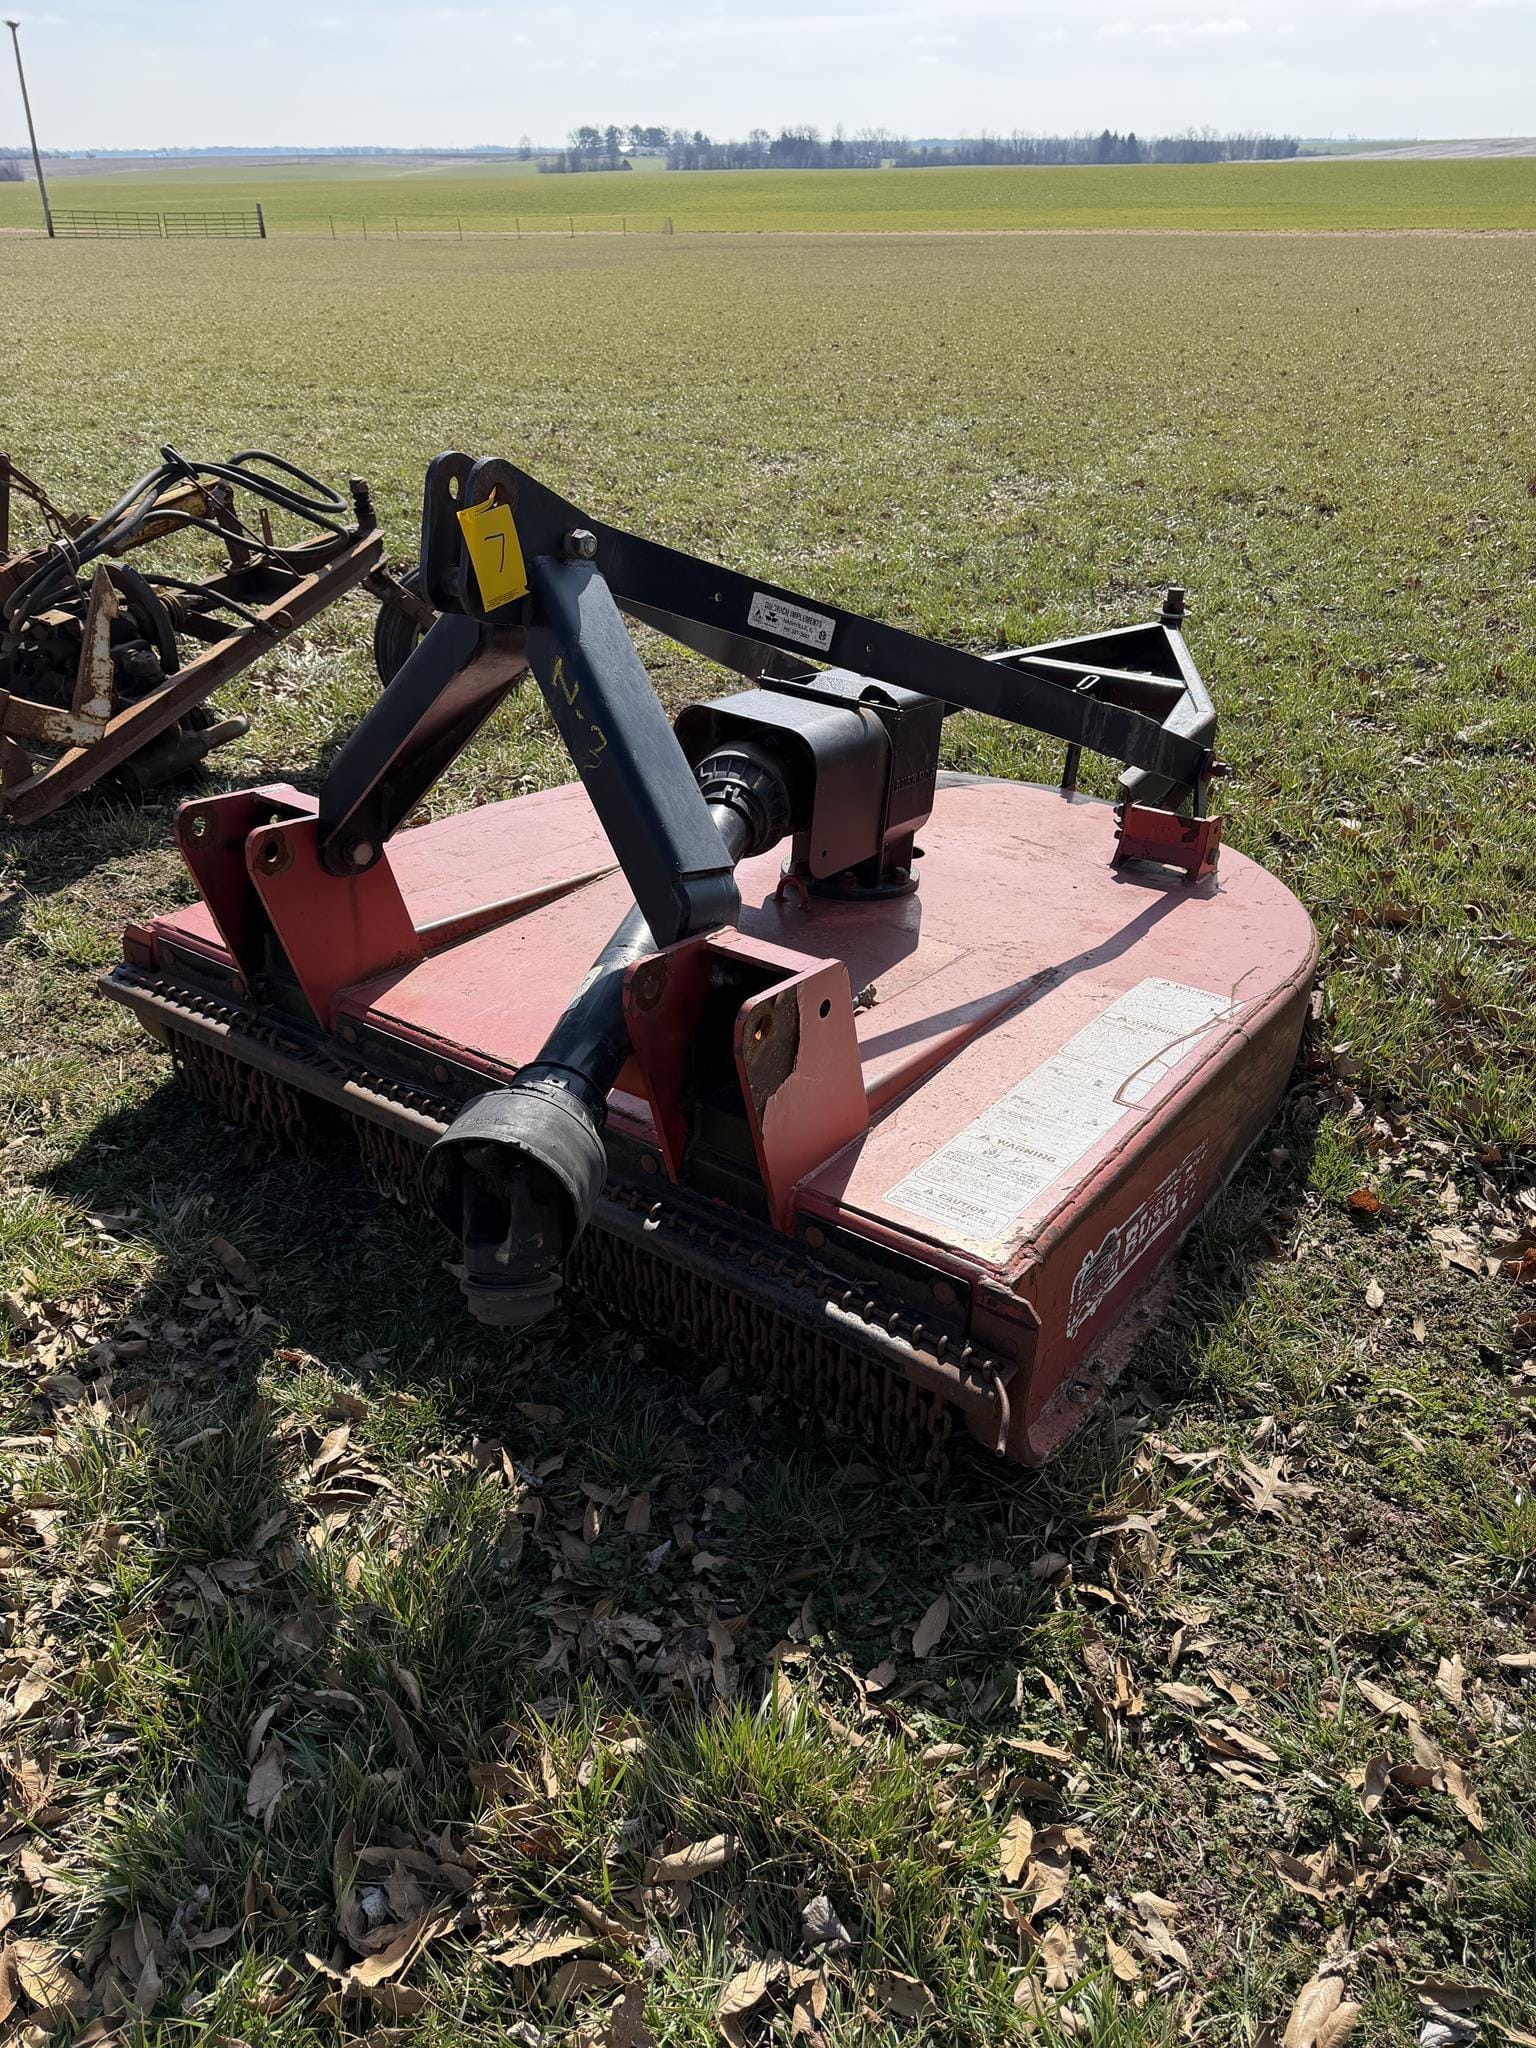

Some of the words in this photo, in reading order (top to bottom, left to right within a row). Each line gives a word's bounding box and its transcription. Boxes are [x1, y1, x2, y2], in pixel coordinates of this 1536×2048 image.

[484, 532, 505, 574] 7
[789, 610, 823, 628] IMPLEMENTS
[997, 1138, 1057, 1163] WARNING
[938, 1193, 988, 1215] CAUTION
